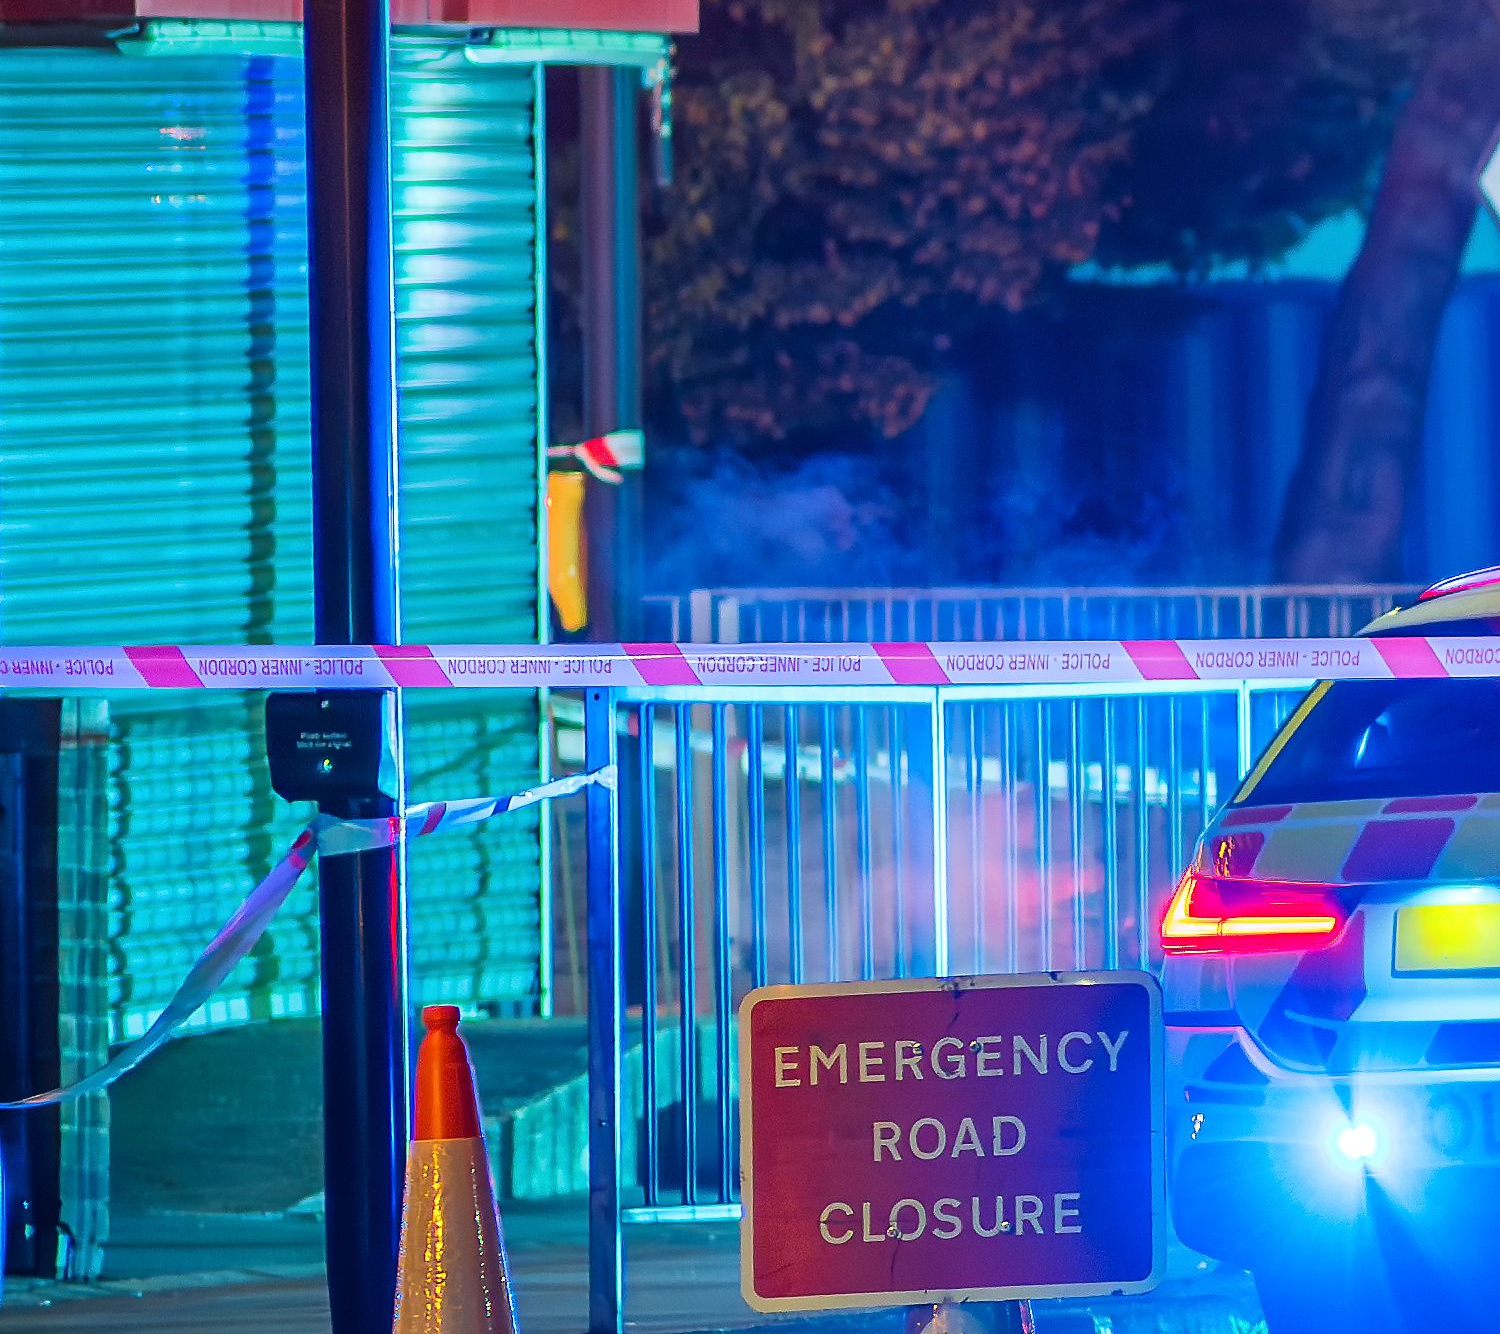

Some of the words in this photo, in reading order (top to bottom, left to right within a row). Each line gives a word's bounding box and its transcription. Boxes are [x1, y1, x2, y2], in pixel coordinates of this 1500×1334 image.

[698, 656, 755, 673] CORDON
[760, 656, 800, 673] INNER
[812, 656, 861, 672] POLICE
[946, 654, 1004, 671] CORDON
[1009, 654, 1049, 670] INNER
[1062, 653, 1111, 670] POLICE
[1196, 651, 1254, 667] CORDON
[1258, 651, 1298, 667] INNER
[1311, 650, 1360, 666] POLICE
[12, 660, 53, 675] INNER
[66, 660, 113, 675] POLICE
[199, 659, 257, 675] CORDON
[262, 659, 302, 675] INNER
[314, 659, 363, 675] POLICE
[448, 659, 505, 674] CORDON
[511, 659, 550, 674] INNER
[563, 659, 612, 674] POLICE
[774, 1030, 1130, 1088] EMERGENCY
[872, 1114, 1027, 1162] ROAD
[818, 1192, 1083, 1244] CLOSURE
